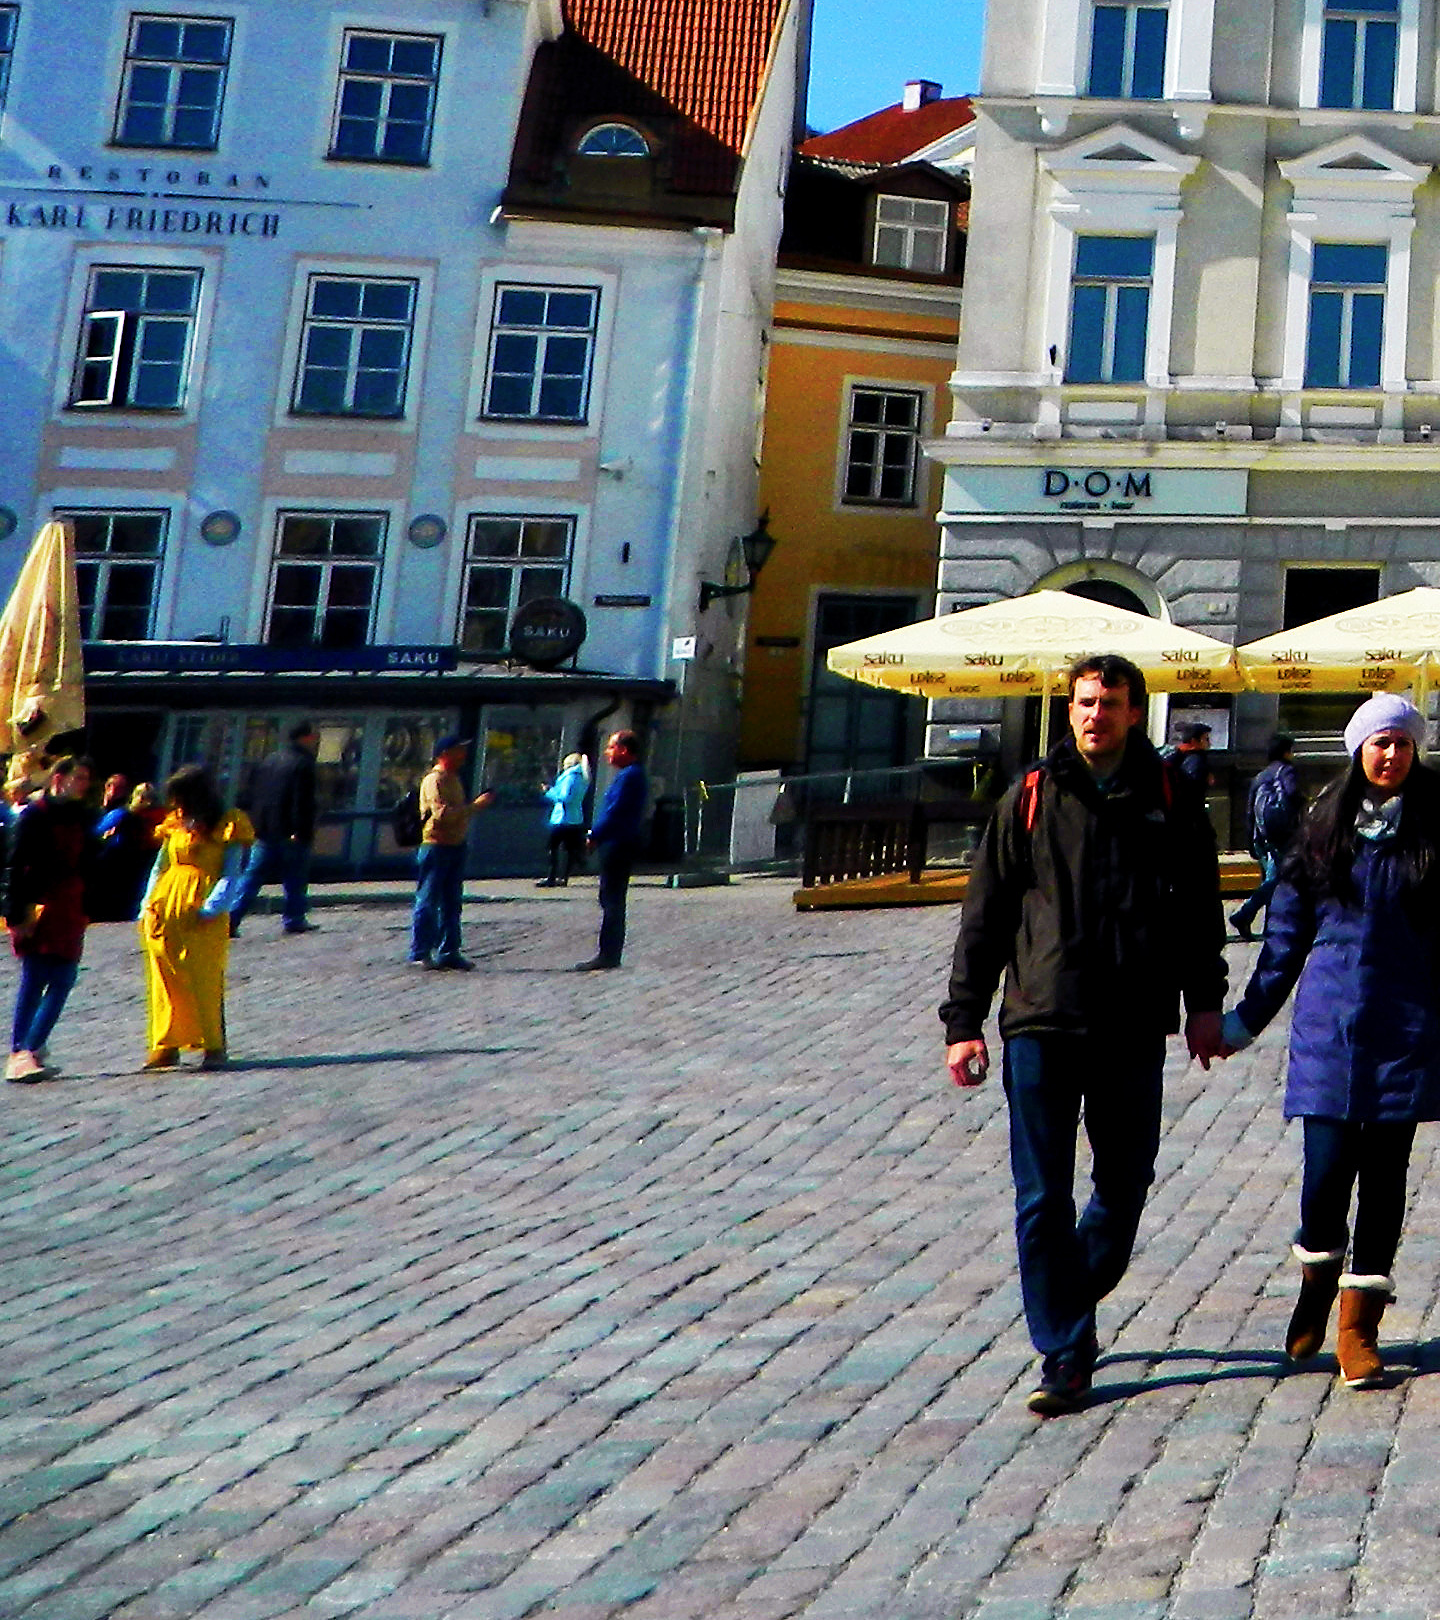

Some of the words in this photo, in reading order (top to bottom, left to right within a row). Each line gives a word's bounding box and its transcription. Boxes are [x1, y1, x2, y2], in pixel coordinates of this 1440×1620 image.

[48, 163, 270, 189] RESTORAN
[7, 202, 87, 228] KARL
[106, 206, 281, 238] FRIEDRICH
[388, 652, 441, 665] SAKU
